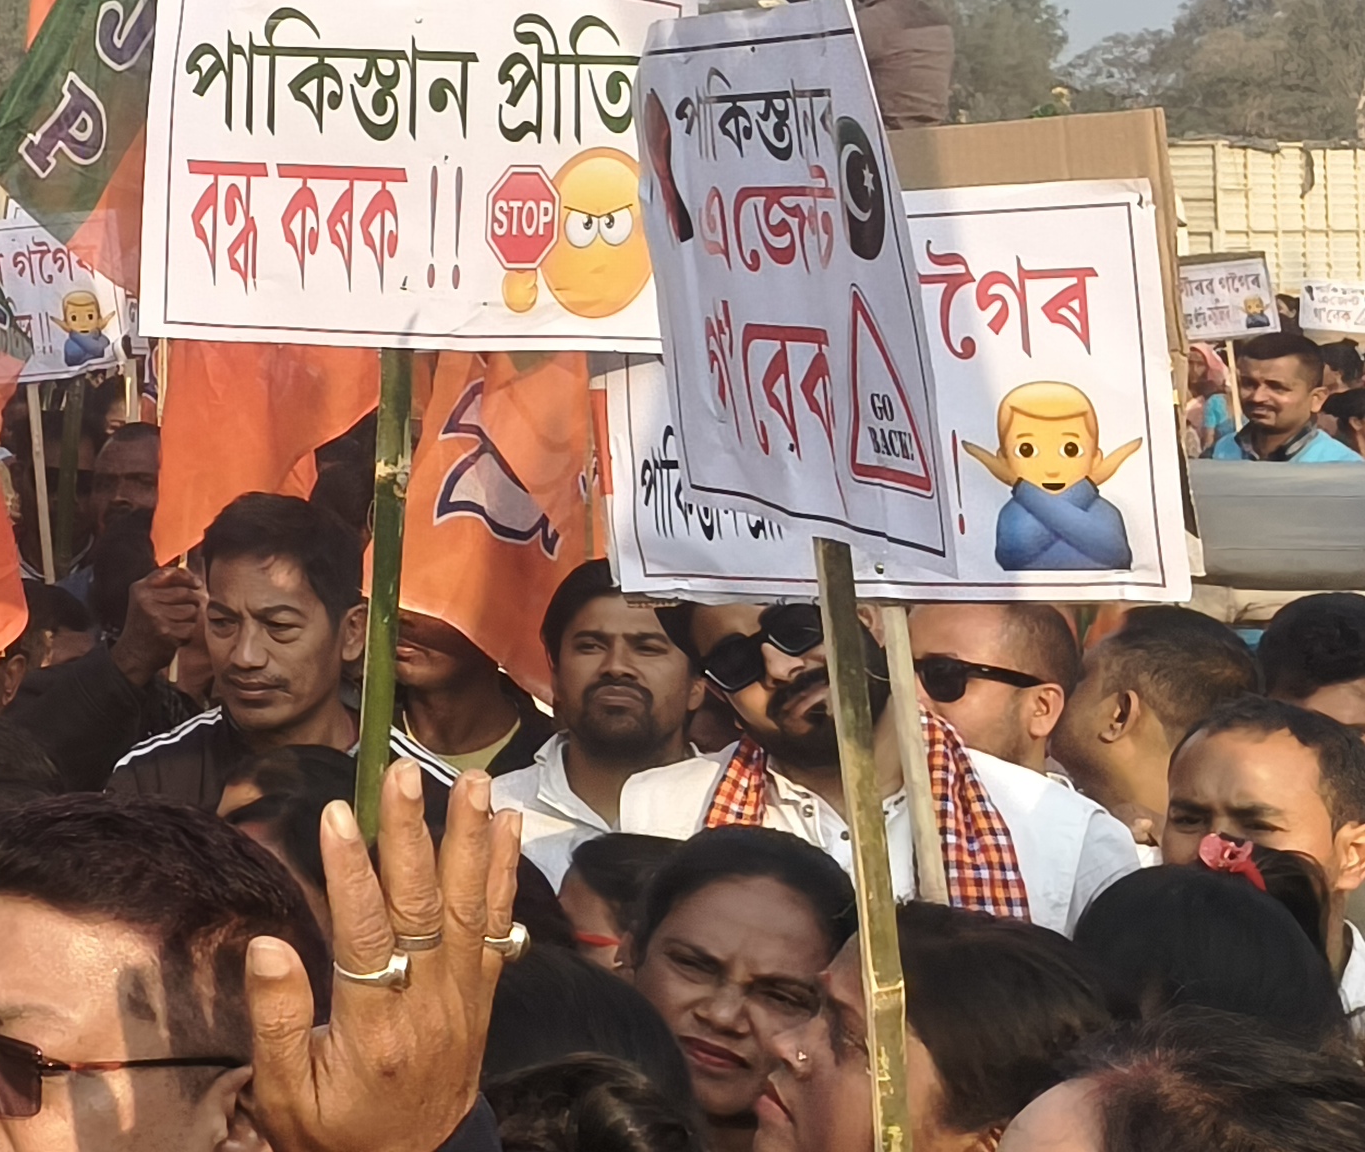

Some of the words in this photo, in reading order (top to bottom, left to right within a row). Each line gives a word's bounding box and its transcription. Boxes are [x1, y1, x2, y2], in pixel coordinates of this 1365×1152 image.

[185, 7, 479, 141] পাকিস্তান
[187, 159, 268, 295] বন্ধ
[493, 199, 553, 236] STOP
[870, 393, 894, 422] GO
[868, 425, 915, 461] BACK!
